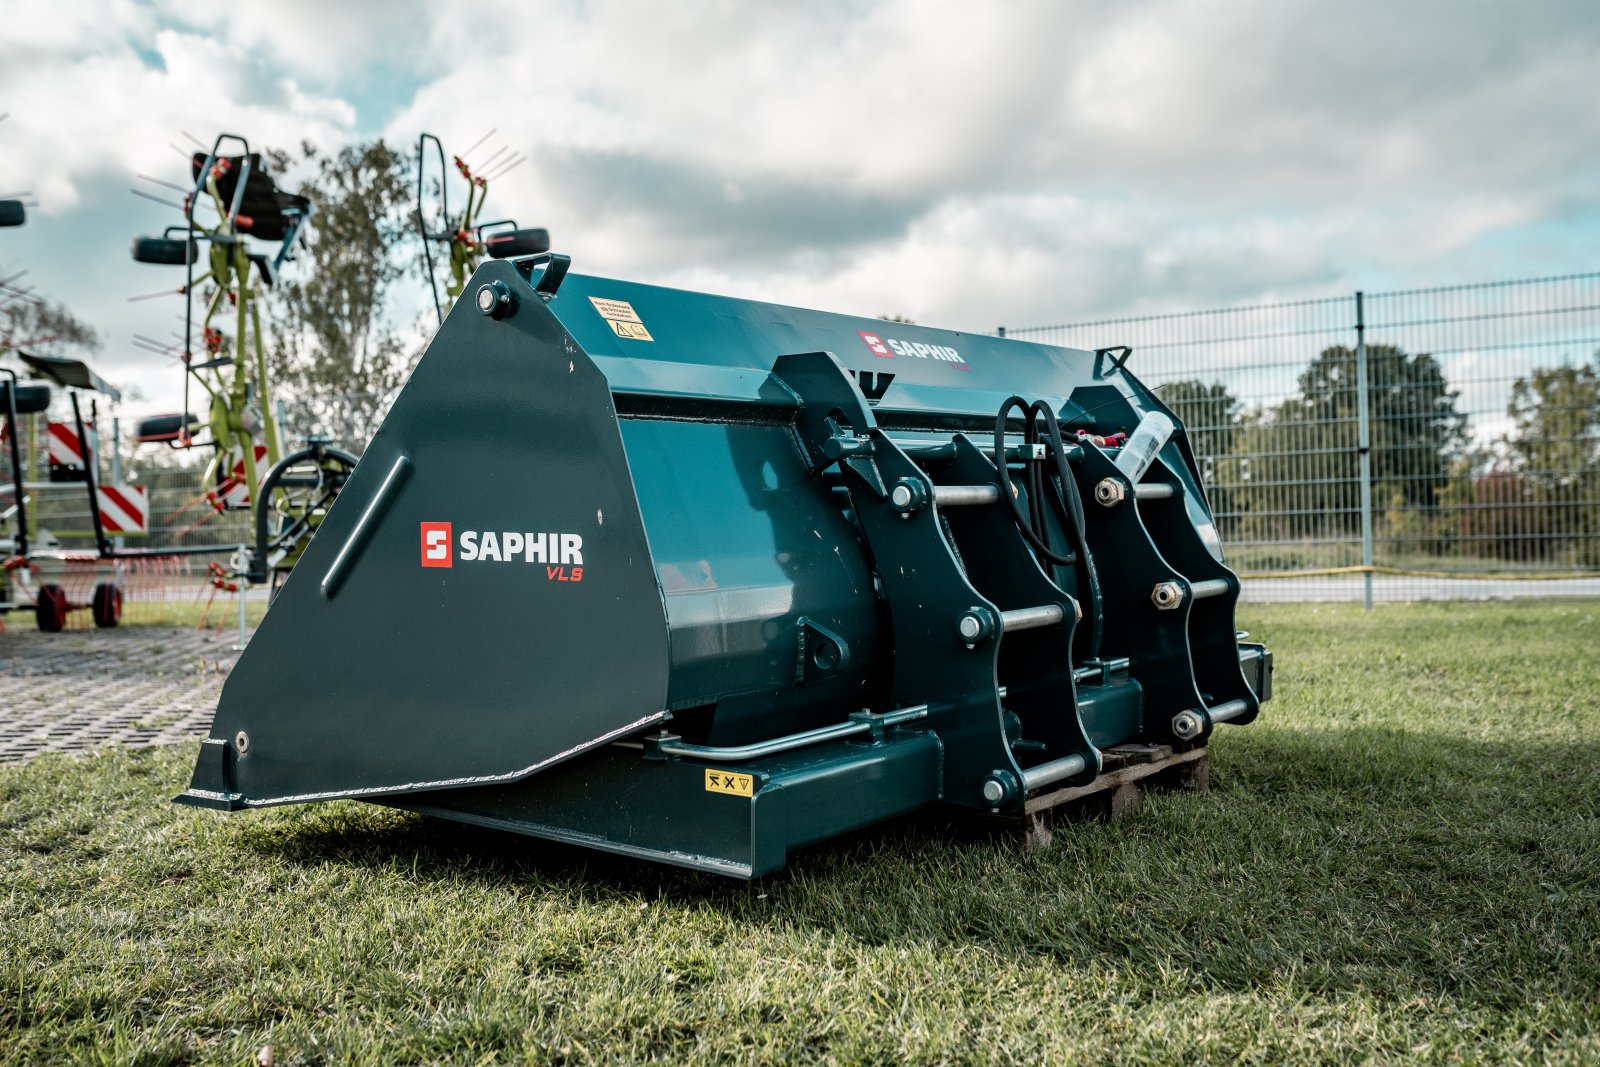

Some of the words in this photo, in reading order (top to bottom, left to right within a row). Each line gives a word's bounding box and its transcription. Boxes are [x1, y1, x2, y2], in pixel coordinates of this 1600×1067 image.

[887, 338, 966, 363] SAPHIR
[460, 531, 584, 565] SAPHIR
[546, 566, 584, 582] VLS
